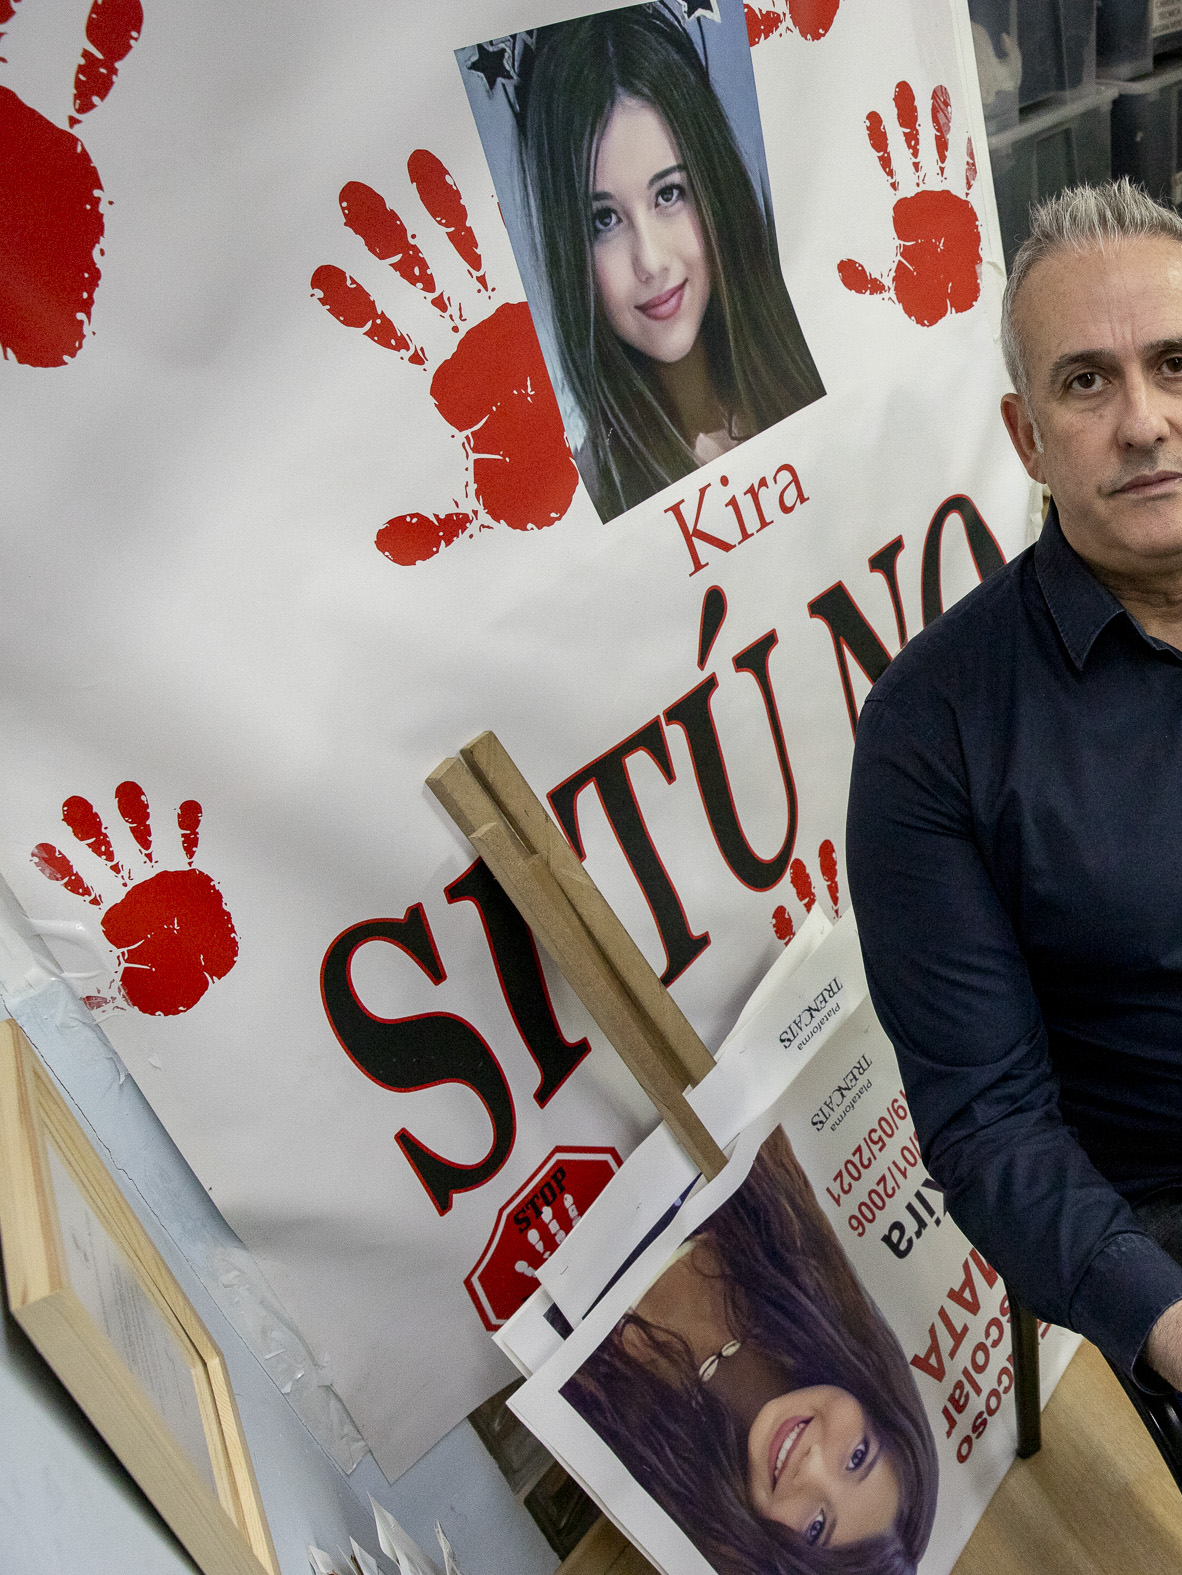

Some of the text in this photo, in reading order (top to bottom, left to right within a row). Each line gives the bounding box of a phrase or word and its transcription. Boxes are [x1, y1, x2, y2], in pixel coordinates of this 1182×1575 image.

[664, 463, 810, 577] Kira
[320, 856, 591, 1217] SI
[546, 585, 799, 989] TÚ
[779, 975, 844, 1050] TRENCATS
[797, 1002, 841, 1052] Plataforma
[811, 1053, 873, 1132] TRENCATS
[830, 1078, 874, 1132] Plataforma
[513, 1166, 567, 1234] STOP
[941, 1293, 1011, 1439] scolar
[956, 1350, 1015, 1464] coso
